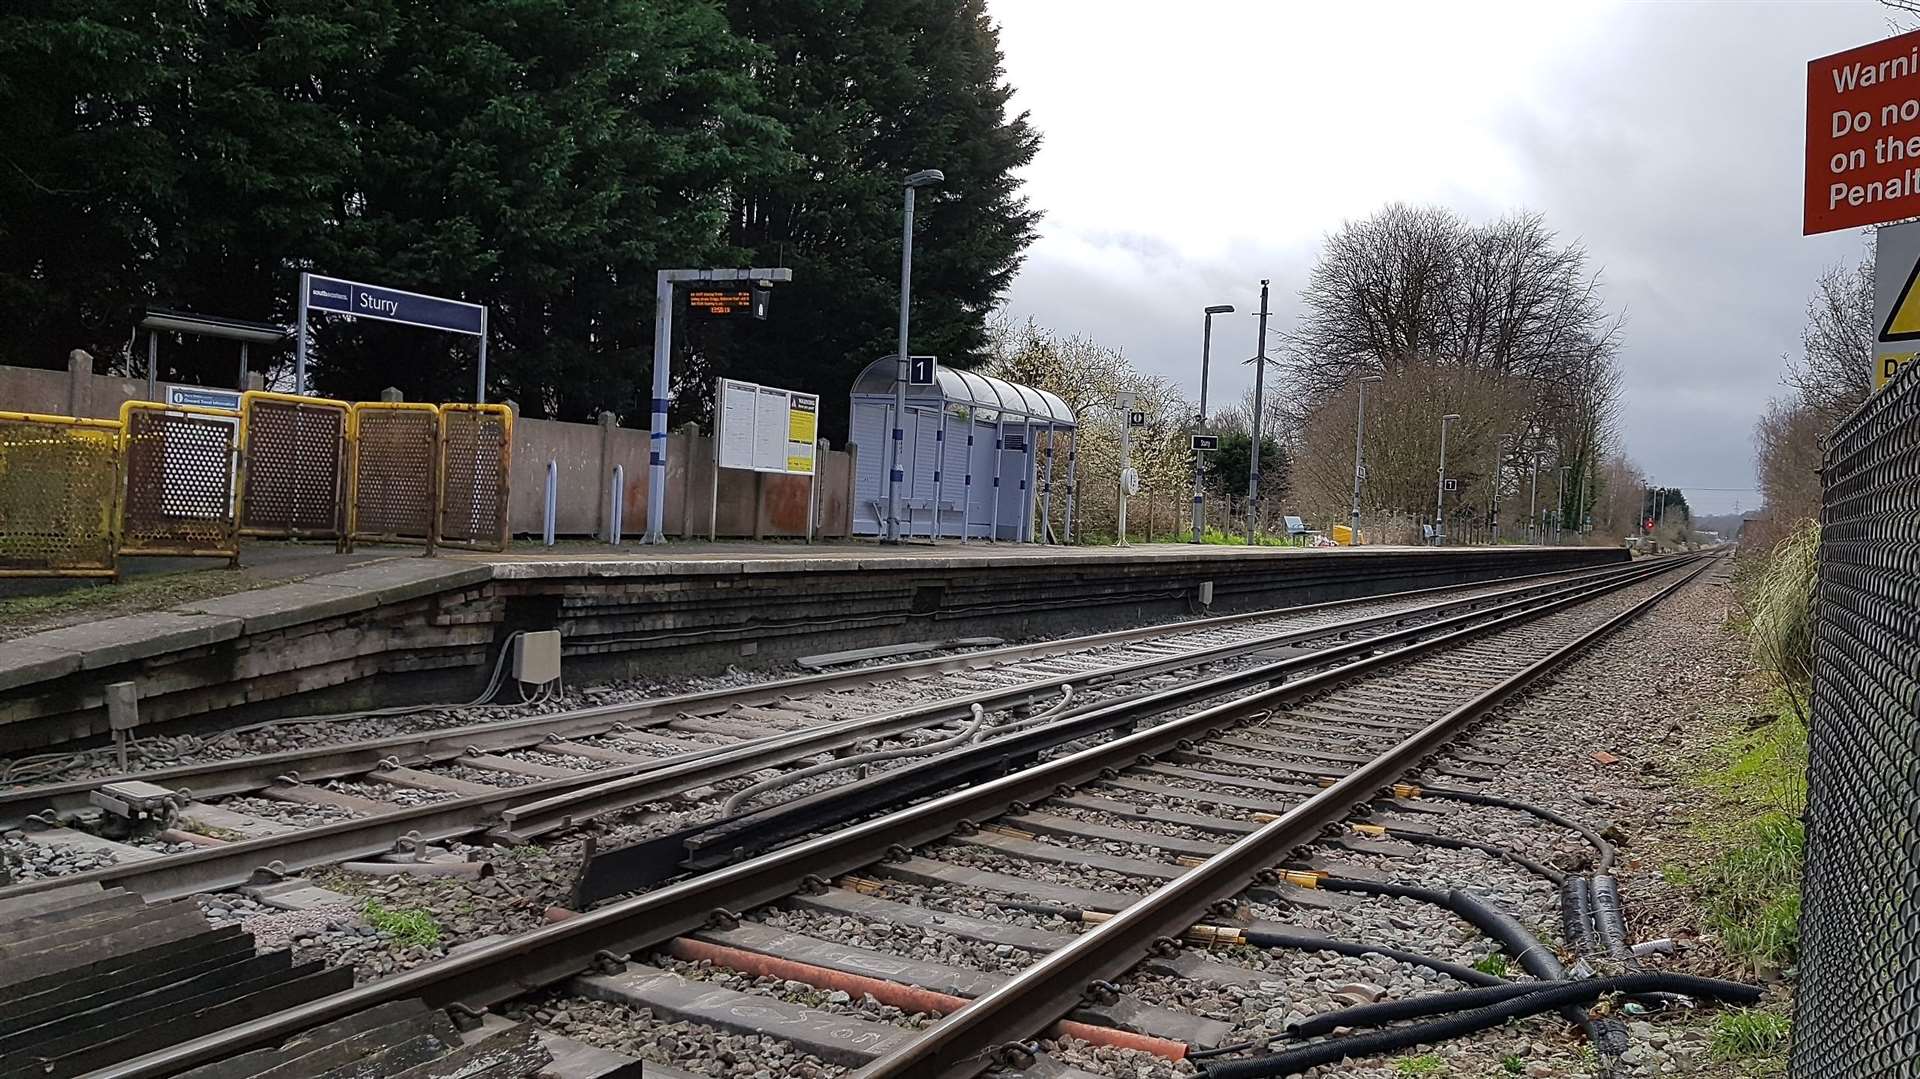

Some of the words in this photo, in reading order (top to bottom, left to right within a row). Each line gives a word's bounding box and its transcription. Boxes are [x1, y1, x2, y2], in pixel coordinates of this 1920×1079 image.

[1832, 47, 1919, 94] Warni
[1832, 110, 1872, 138] Do
[1830, 149, 1866, 174] on
[1875, 135, 1920, 164] the
[360, 292, 399, 316] Sturry
[916, 361, 924, 381] 1
